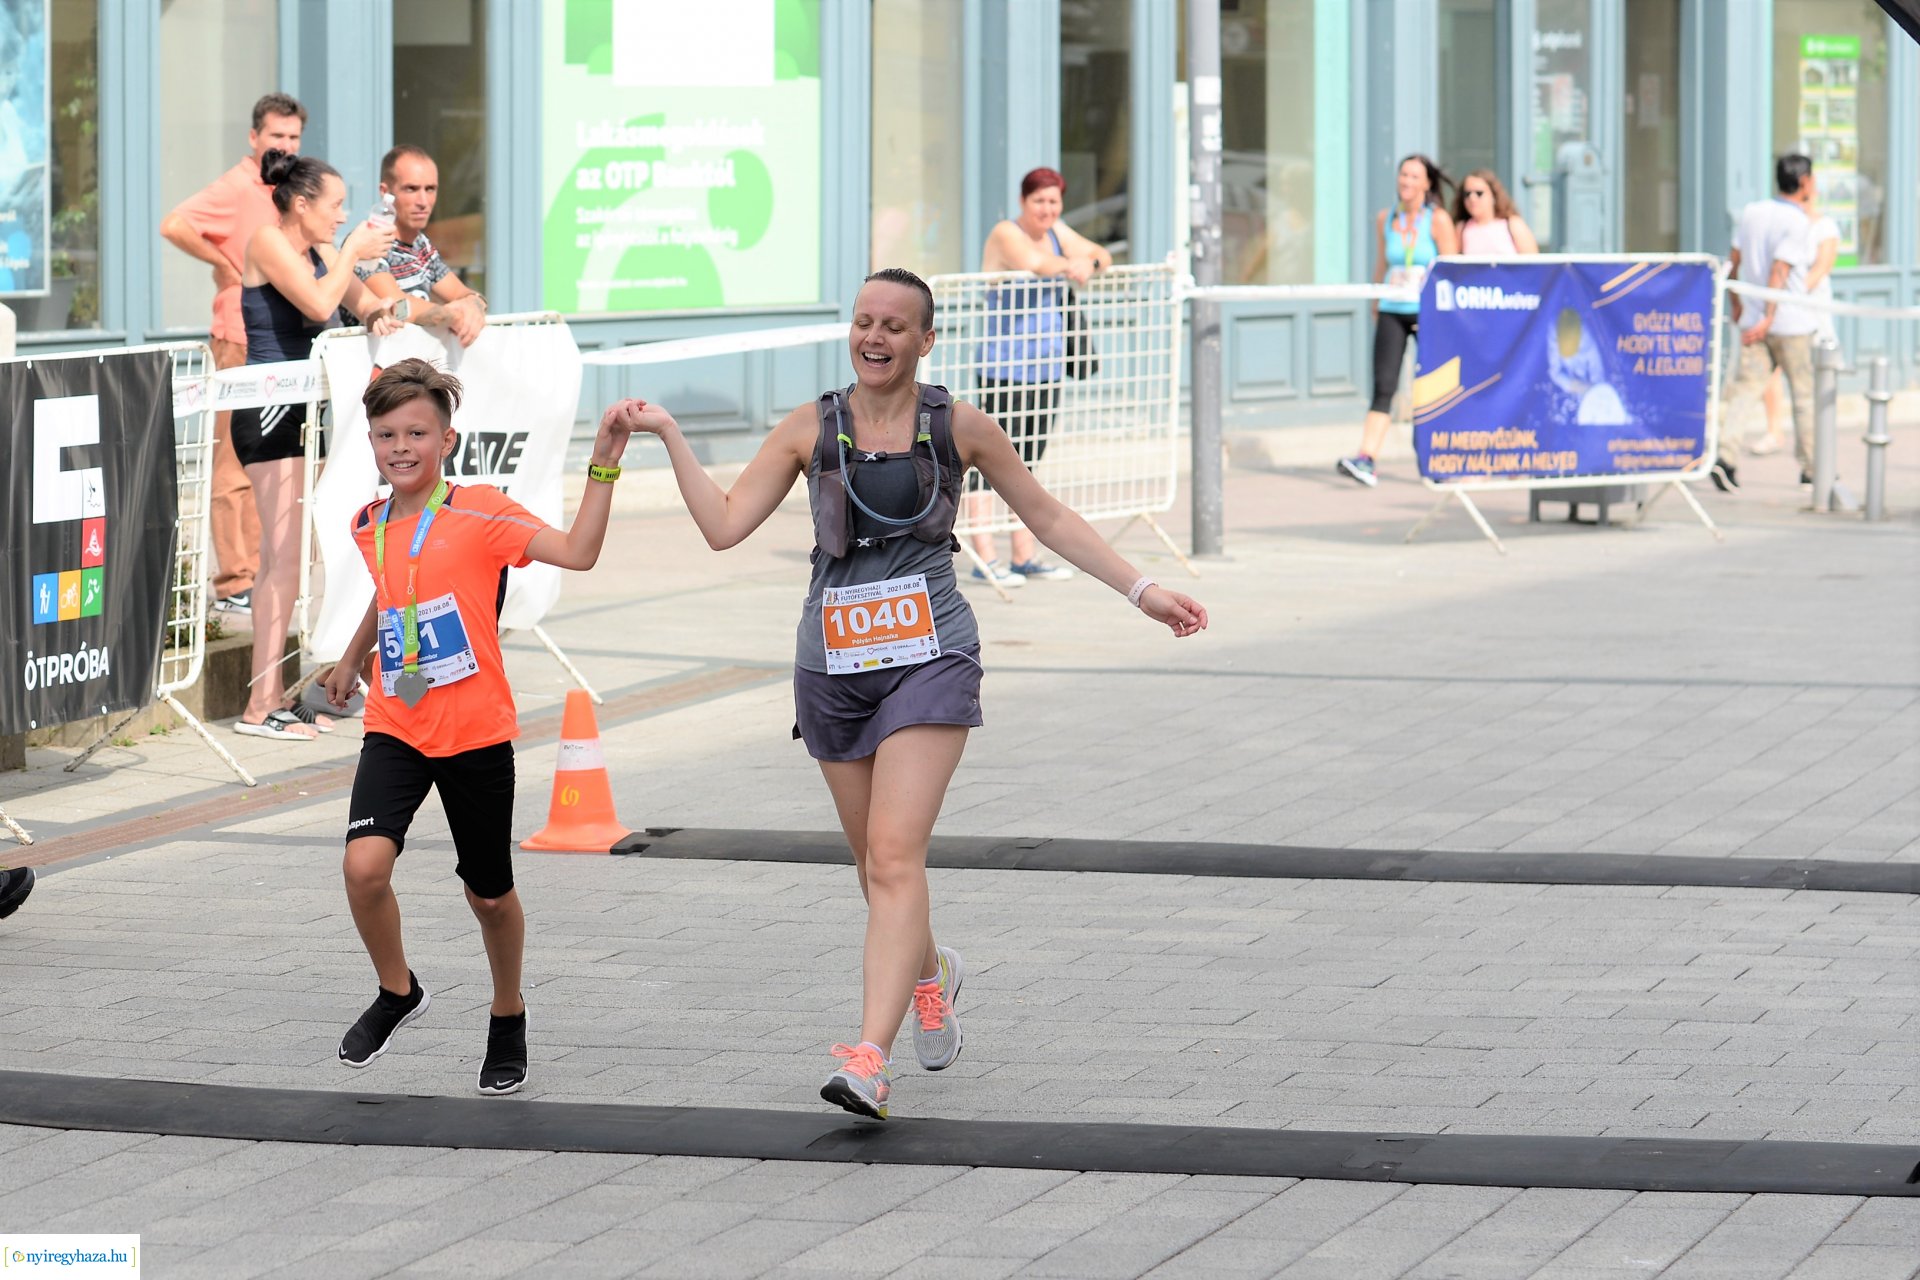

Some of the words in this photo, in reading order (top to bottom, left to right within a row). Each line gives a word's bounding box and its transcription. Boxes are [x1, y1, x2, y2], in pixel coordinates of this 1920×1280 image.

[576, 168, 602, 190] az
[605, 160, 650, 190] OTP
[1632, 356, 1646, 375] A
[1428, 453, 1466, 473] HOGY
[1521, 452, 1531, 471] A
[830, 598, 919, 637] 1040
[384, 622, 440, 659] 51
[873, 633, 899, 642] Hajnalka
[24, 641, 110, 691] ÖTPRÓBA
